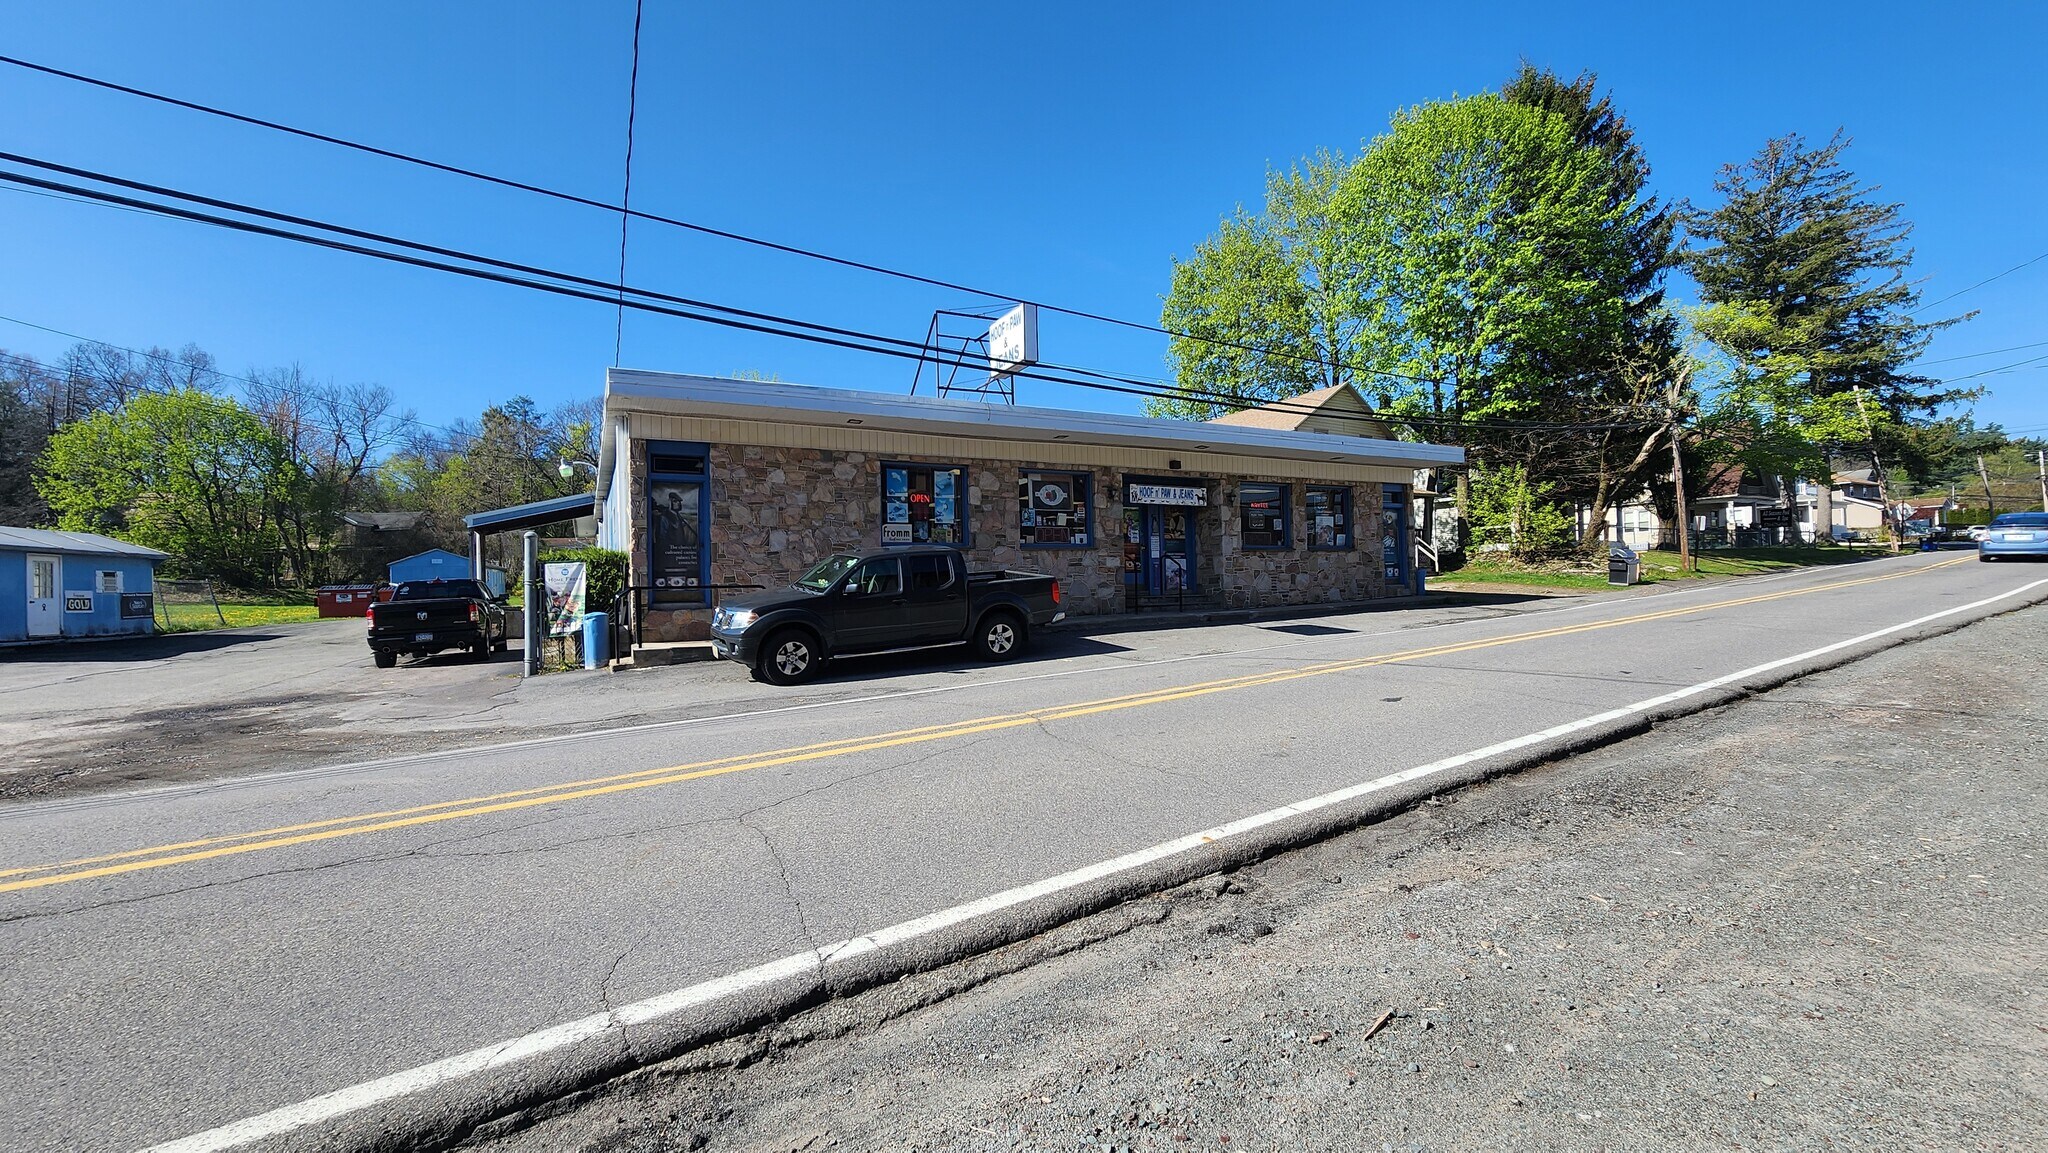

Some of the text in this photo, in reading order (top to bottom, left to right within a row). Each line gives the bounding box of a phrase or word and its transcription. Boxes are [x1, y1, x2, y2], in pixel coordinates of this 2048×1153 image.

[990, 321, 1005, 343] HOOF
[1010, 310, 1022, 330] PAW
[910, 494, 930, 503] OPEN
[1139, 487, 1154, 498] HOOF
[1160, 488, 1171, 499] PAW
[1173, 488, 1177, 499] &
[1178, 489, 1194, 500] JEANS
[883, 526, 910, 538] fromm
[68, 599, 90, 610] GOLD
